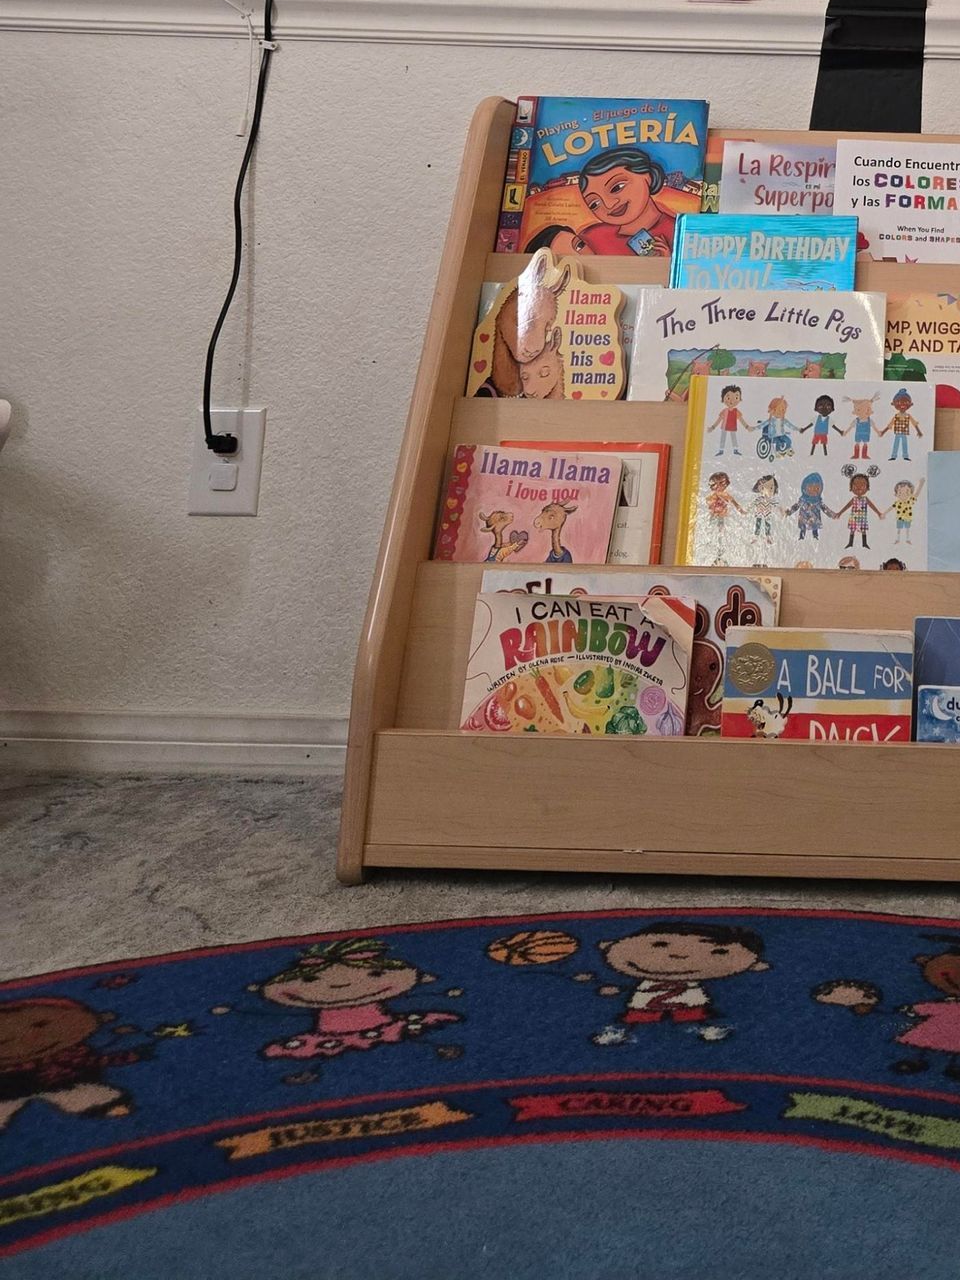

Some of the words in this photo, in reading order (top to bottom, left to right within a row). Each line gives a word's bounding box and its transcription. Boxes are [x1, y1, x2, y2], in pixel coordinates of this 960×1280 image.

[593, 109, 605, 120] El
[606, 107, 638, 120] juego
[641, 104, 654, 113] de
[658, 103, 669, 113] la
[537, 120, 580, 139] Playing
[541, 112, 699, 166] LOTERÍA
[739, 152, 761, 176] La
[769, 154, 836, 183] Respir
[854, 156, 902, 168] Cuando
[853, 175, 871, 187] los
[754, 184, 835, 213] Superpo
[851, 196, 859, 209] y
[863, 195, 881, 207] las
[878, 233, 913, 242] COLORS
[914, 235, 928, 243] and
[897, 225, 917, 233] When
[918, 226, 930, 234] You
[931, 226, 945, 234] Find
[569, 289, 612, 305] llama
[564, 310, 607, 326] llama
[656, 307, 697, 338] The
[701, 296, 756, 324] Three
[764, 301, 820, 327] Little
[824, 308, 862, 343] Pigs
[569, 330, 611, 346] loves
[908, 339, 944, 353] AND
[570, 350, 593, 367] his
[571, 372, 616, 385] mama
[480, 449, 542, 478] llama
[549, 457, 611, 484] llama
[505, 479, 514, 497] i
[514, 482, 548, 500] love
[551, 488, 581, 503] you
[515, 606, 521, 624] I
[531, 601, 582, 620] CAN
[589, 602, 634, 623] EAT
[642, 616, 656, 630] A
[499, 618, 667, 671] RAINBOW
[486, 671, 516, 692] WRITTEN
[518, 665, 528, 674] BY
[614, 658, 622, 666] BY
[776, 658, 792, 692] A
[806, 654, 866, 697] BALL
[873, 664, 905, 694] FOR
[559, 1095, 693, 1114] CARING
[269, 1111, 423, 1147] JUSTICE
